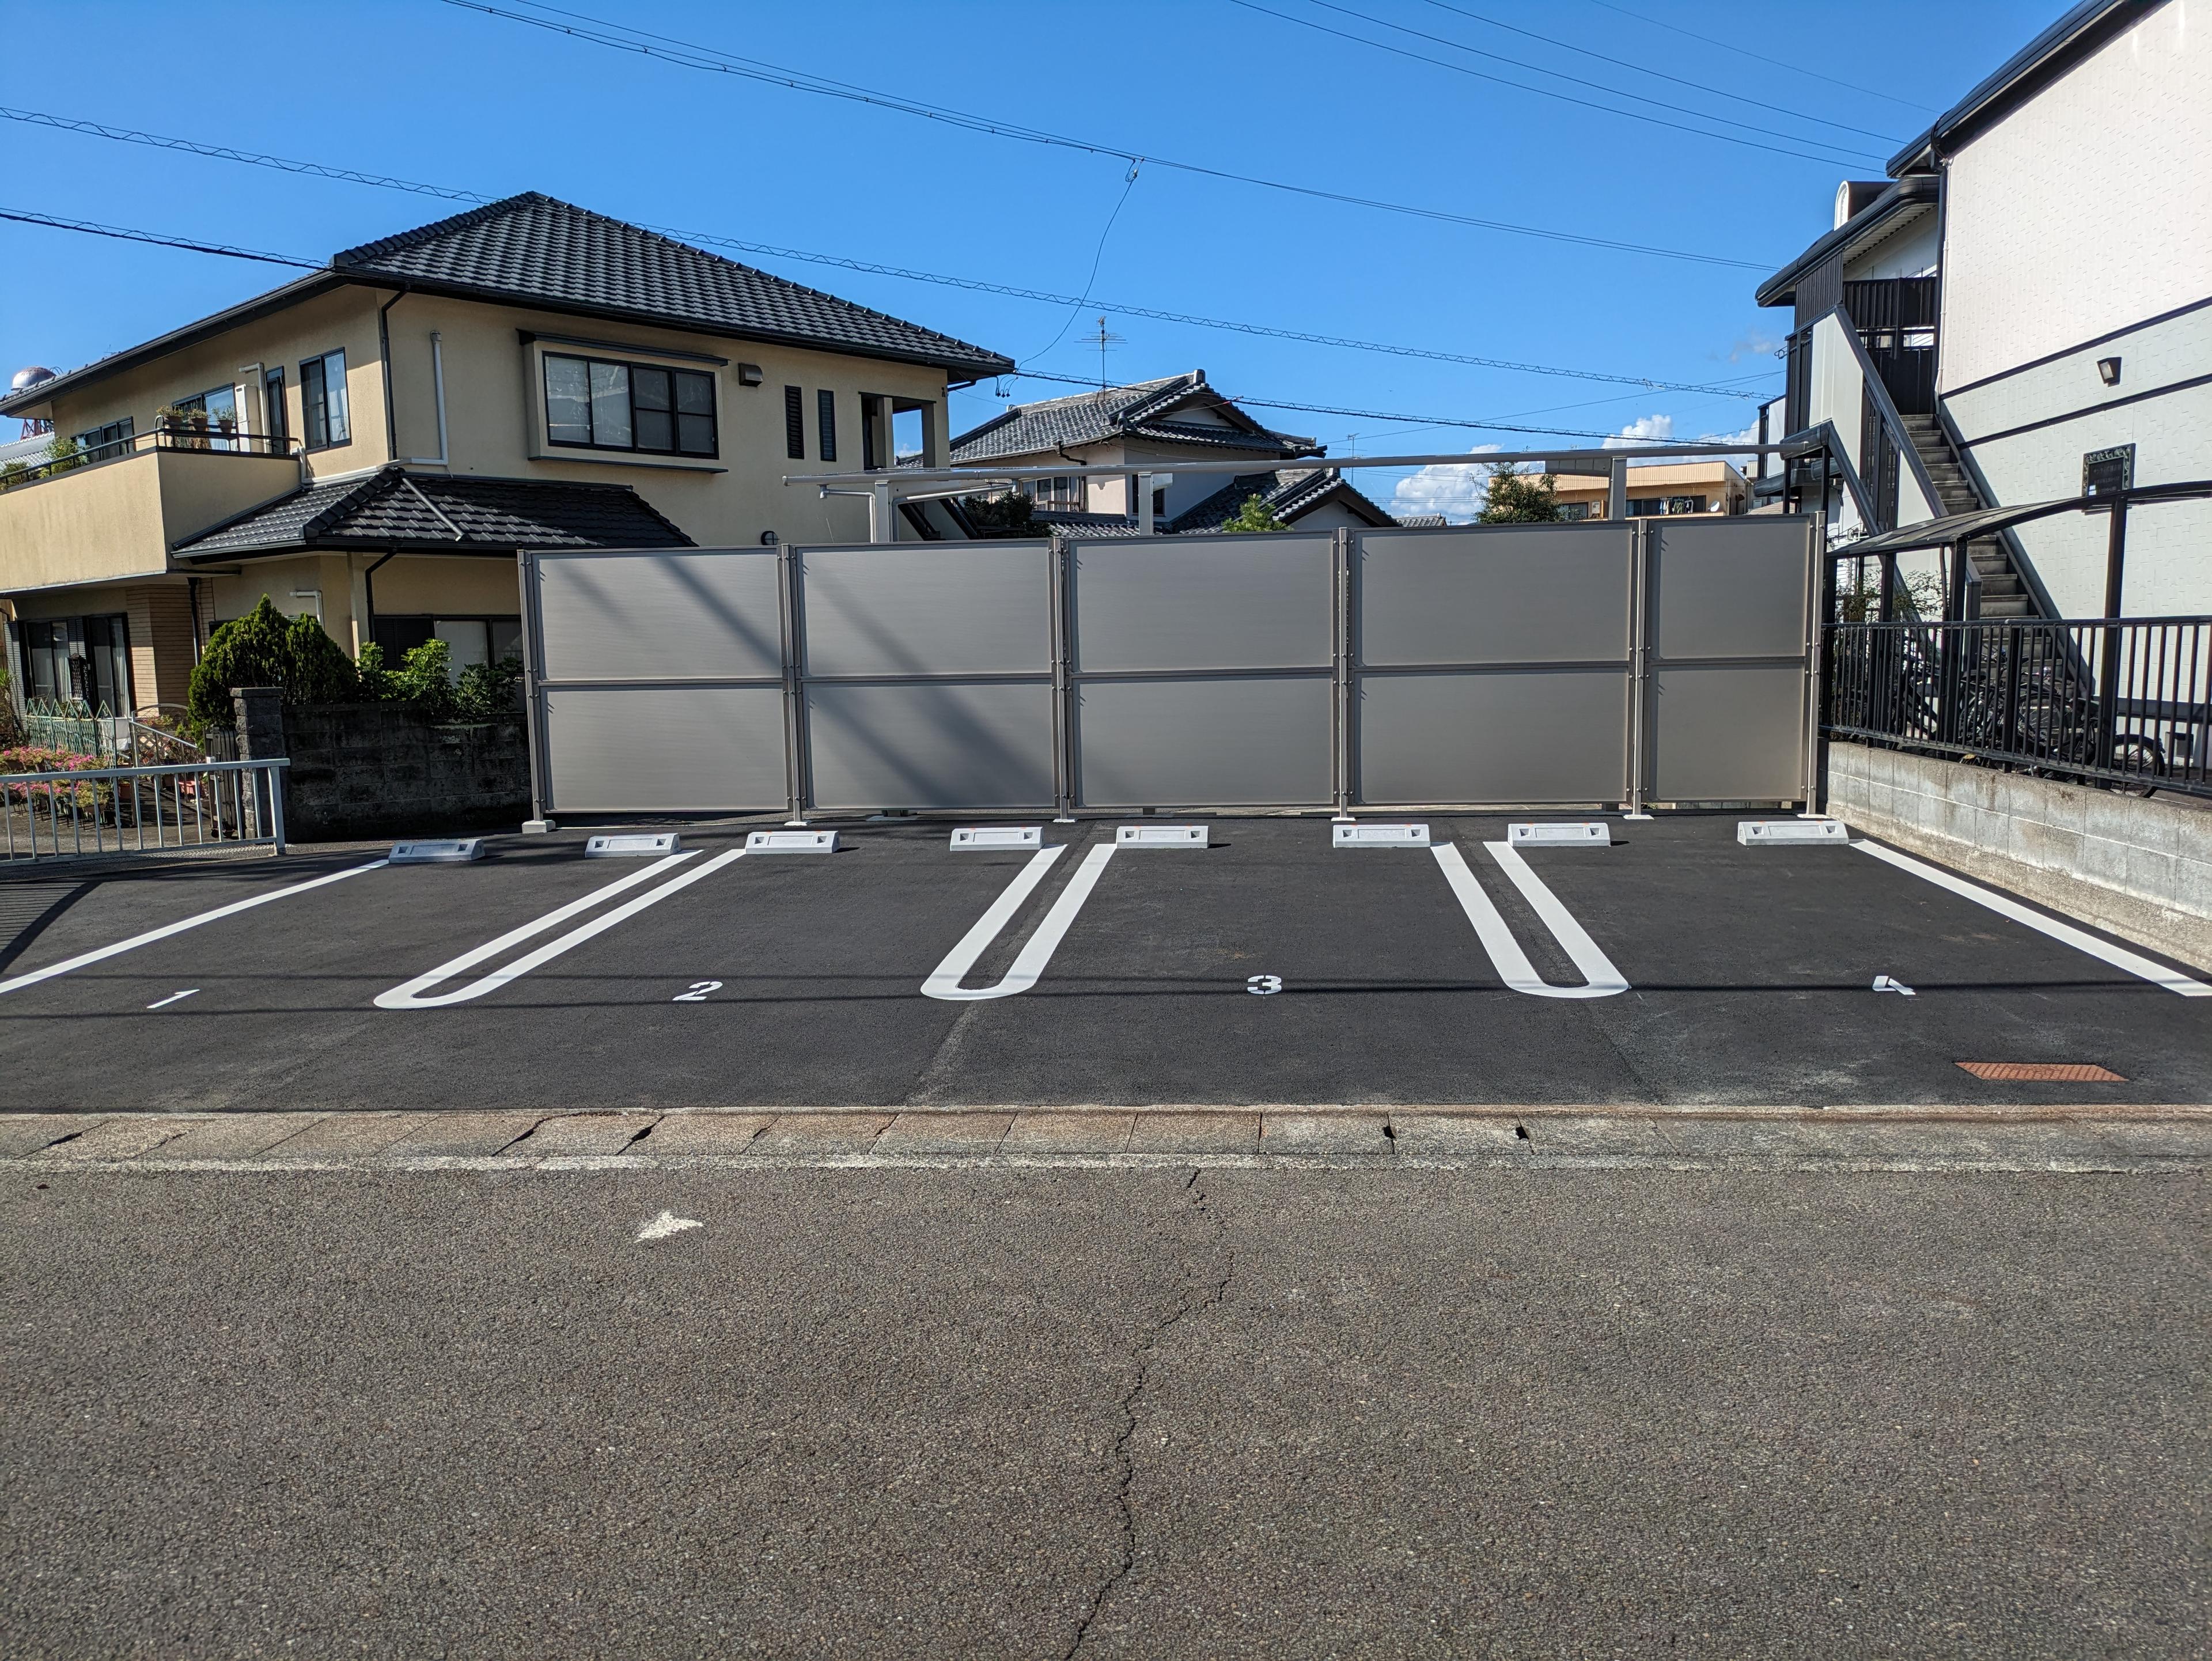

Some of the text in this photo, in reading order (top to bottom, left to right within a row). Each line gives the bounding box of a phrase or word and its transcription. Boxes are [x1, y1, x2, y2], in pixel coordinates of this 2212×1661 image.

[672, 981, 723, 1001] 2
[1247, 975, 1282, 994] 3
[1872, 975, 1916, 995] 4
[146, 989, 200, 1009] 1
